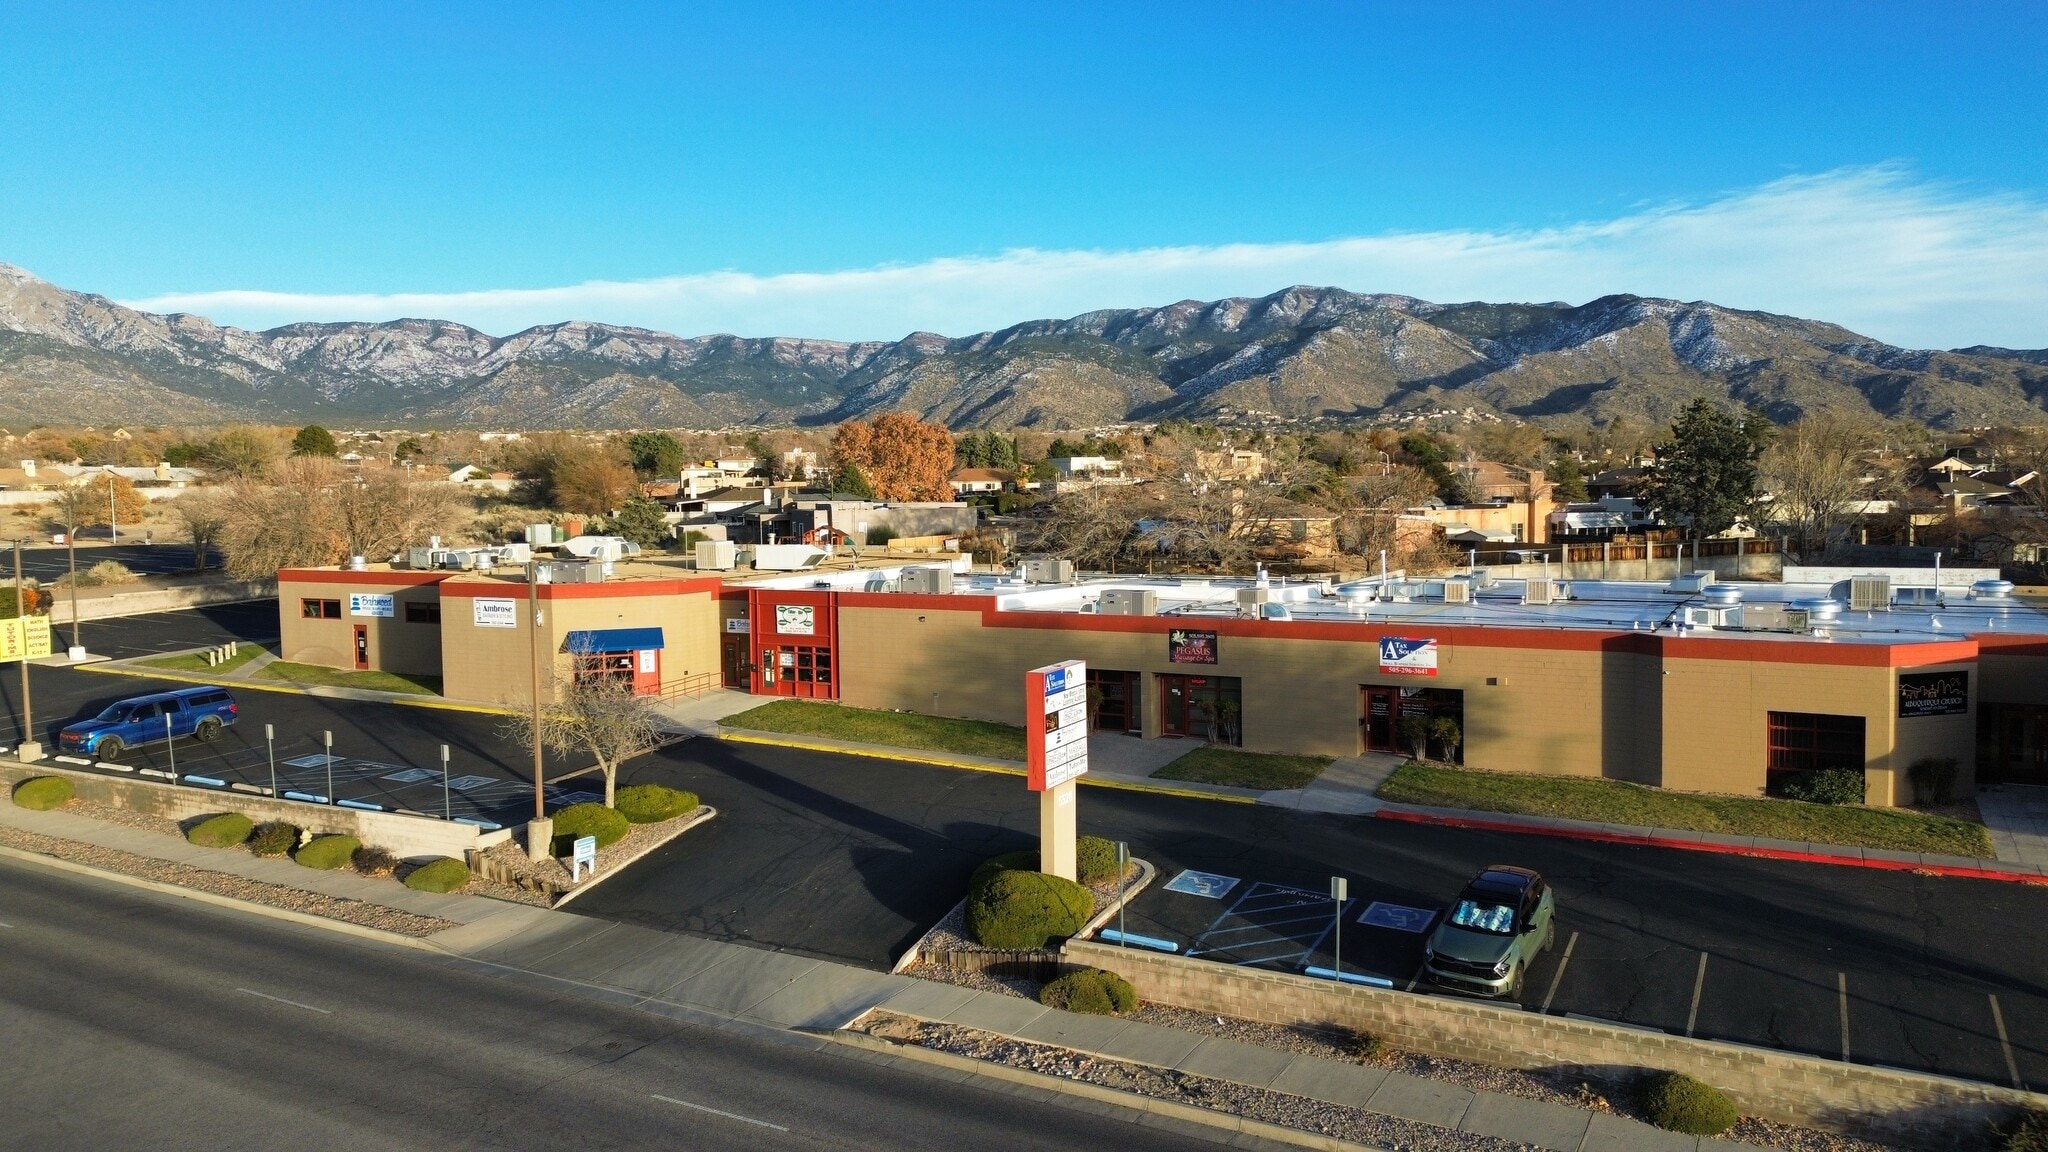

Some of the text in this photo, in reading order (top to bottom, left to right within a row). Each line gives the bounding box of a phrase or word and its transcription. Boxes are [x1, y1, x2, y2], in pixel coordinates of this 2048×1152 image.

[483, 604, 513, 612] Ambrose
[1176, 646, 1211, 655] PEGASUS
[1383, 640, 1399, 659] A
